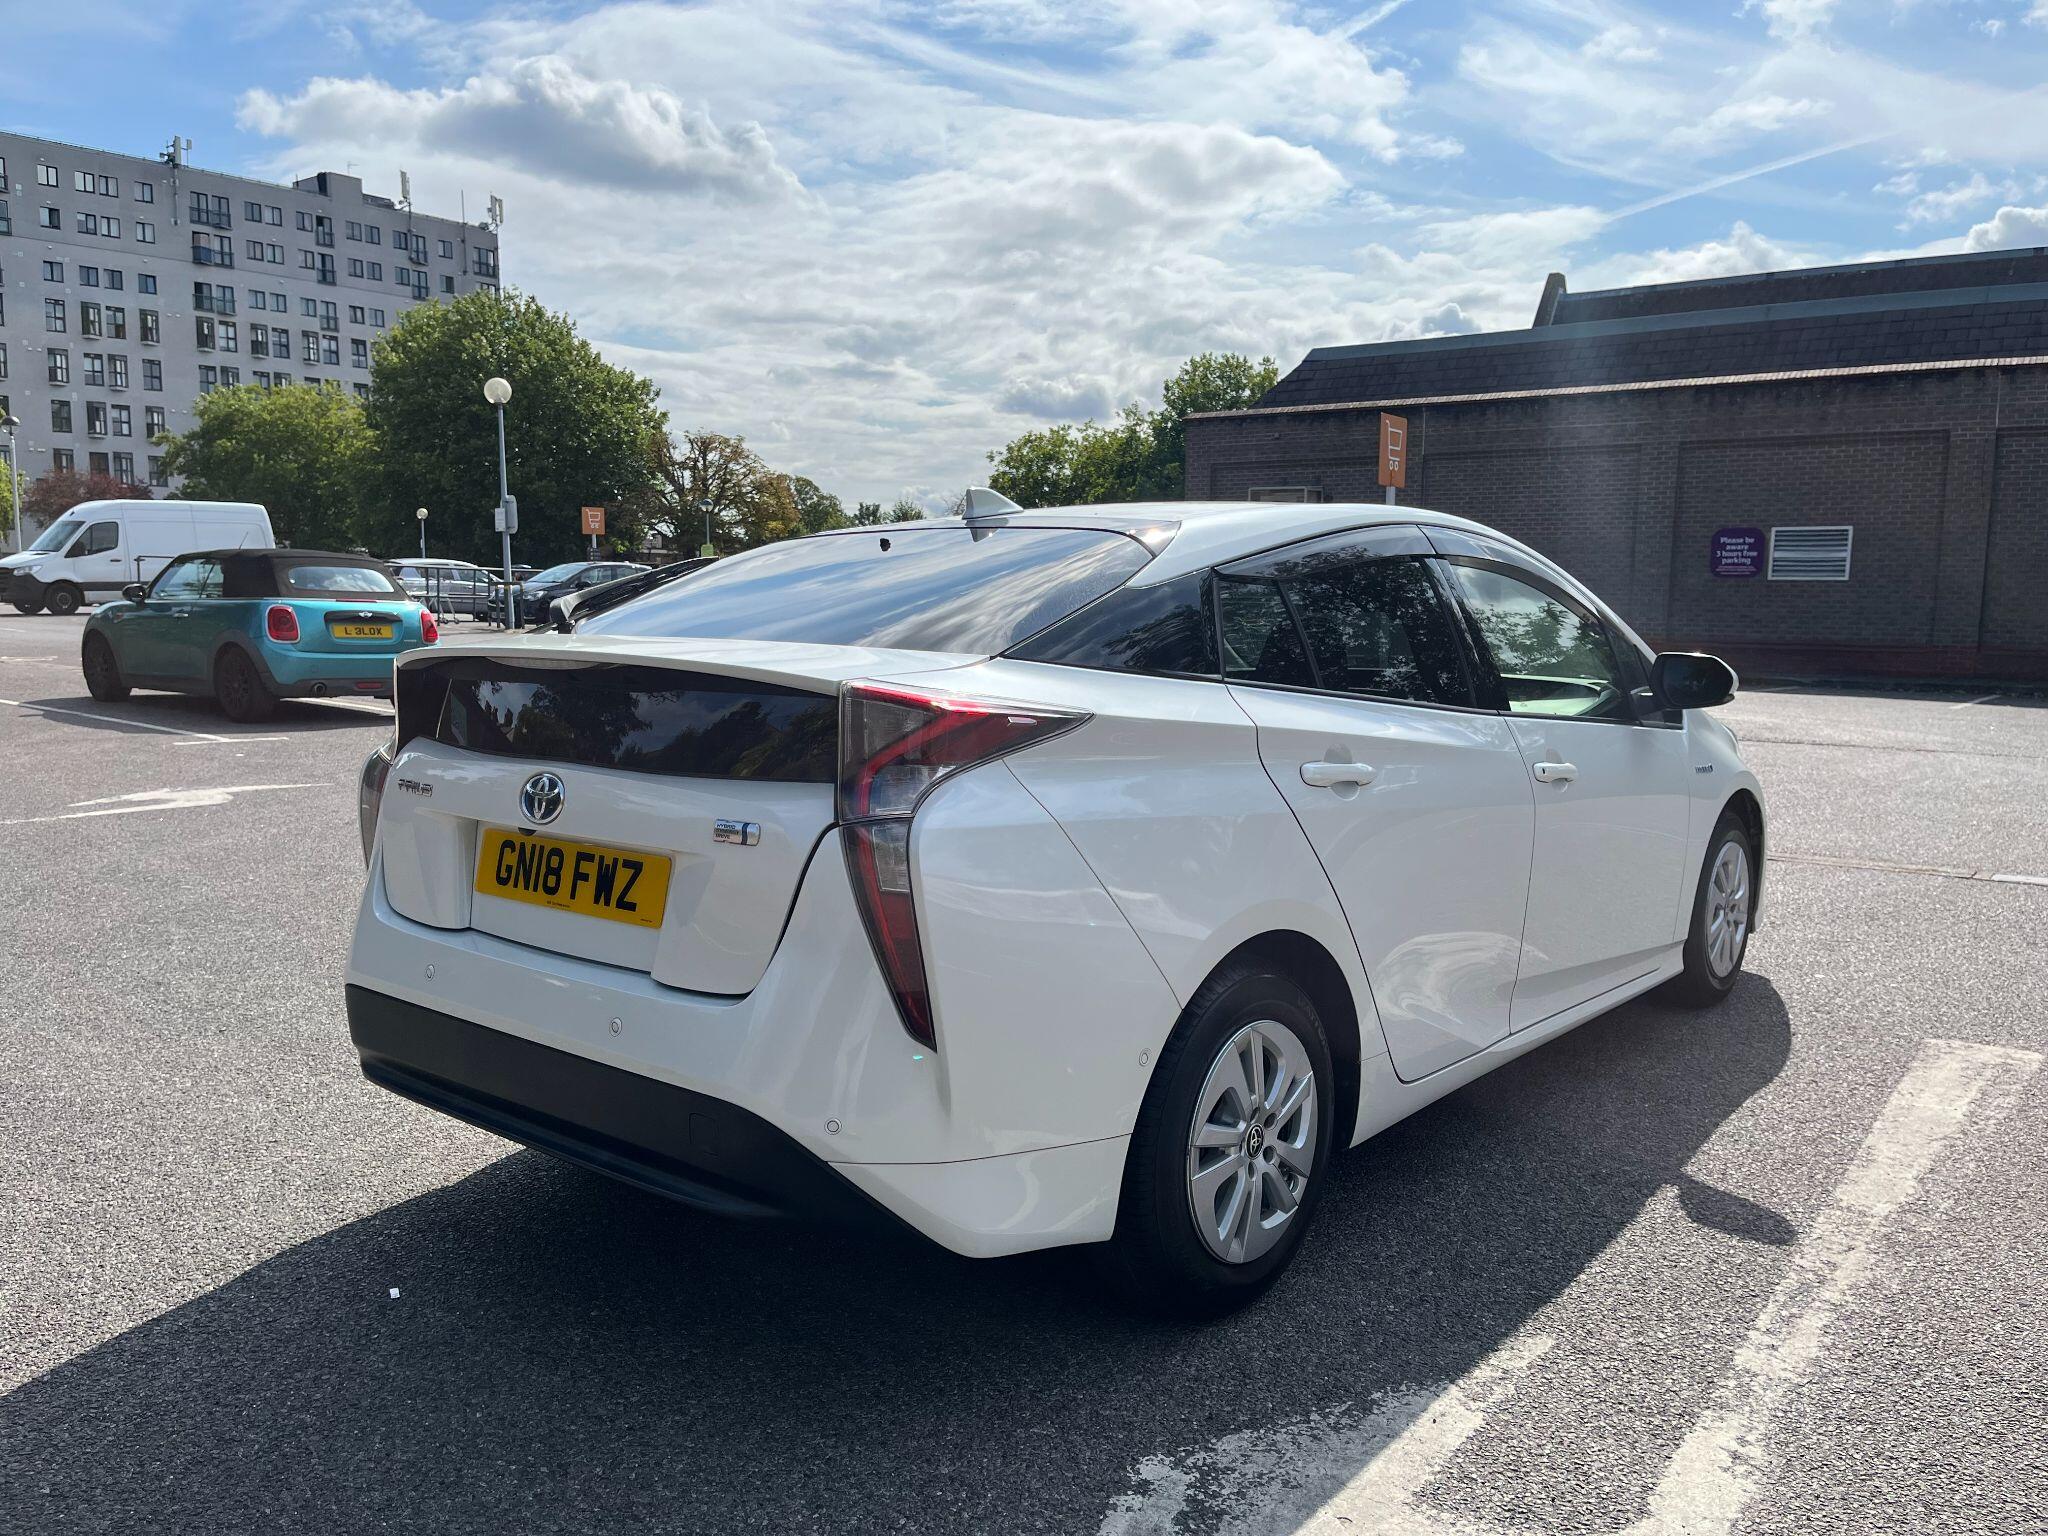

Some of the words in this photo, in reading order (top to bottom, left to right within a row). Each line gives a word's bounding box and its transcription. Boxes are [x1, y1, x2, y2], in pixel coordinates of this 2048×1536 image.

[1722, 557, 1751, 565] parking
[344, 627, 352, 635] L
[496, 840, 565, 896] GN18
[570, 851, 643, 912] FWZ
